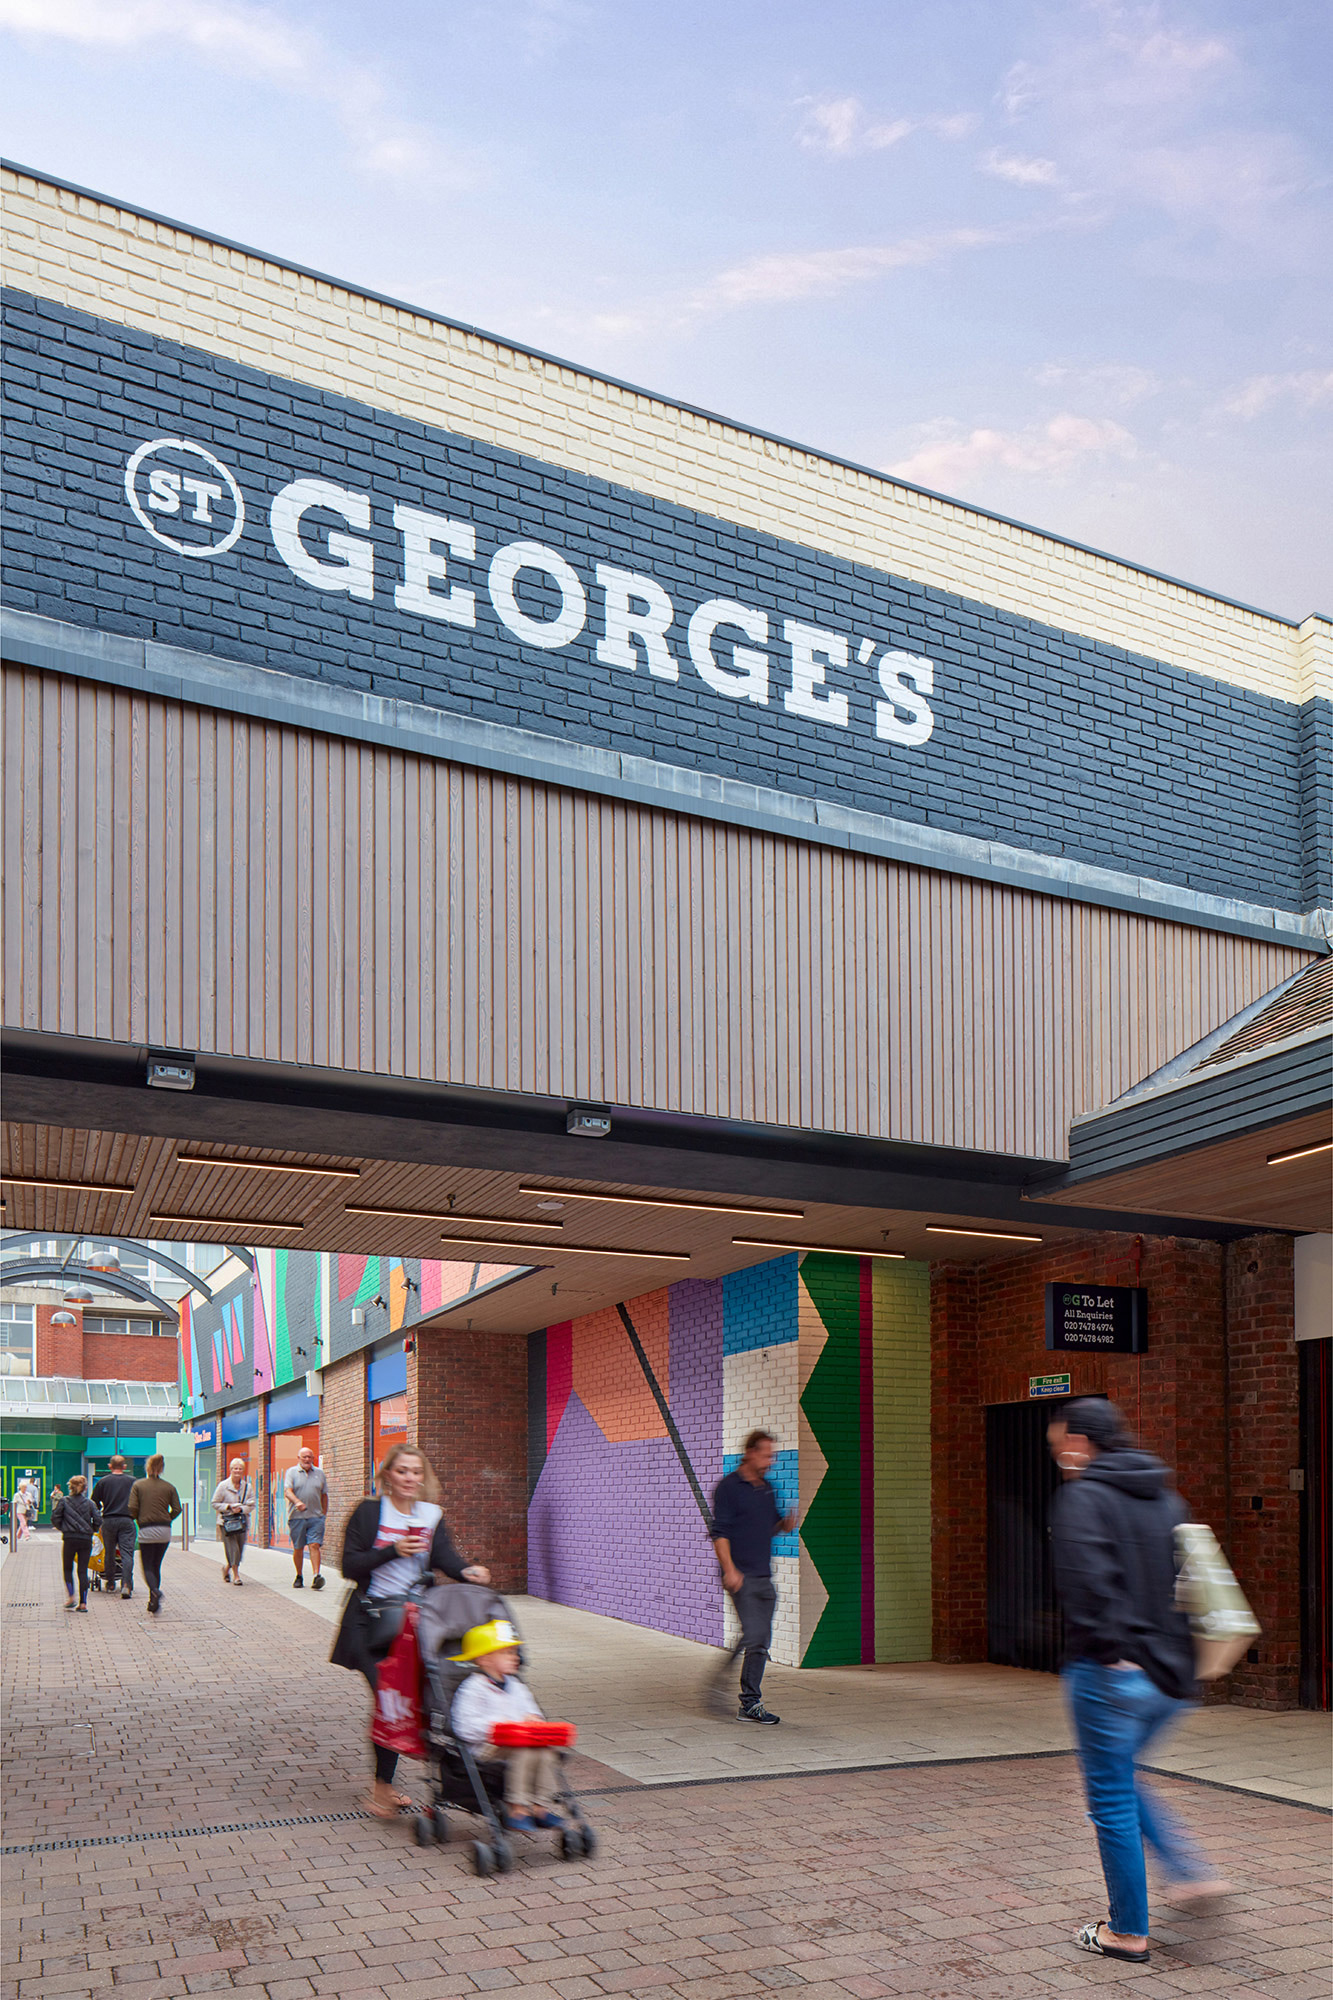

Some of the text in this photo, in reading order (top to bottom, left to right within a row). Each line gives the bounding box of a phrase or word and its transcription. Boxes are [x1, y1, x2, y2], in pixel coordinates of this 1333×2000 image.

[148, 469, 935, 747] ST GEORGE'S
[1072, 1294, 1080, 1306] G
[1081, 1295, 1095, 1307] To
[1097, 1296, 1114, 1308] Let
[1064, 1309, 1113, 1320] All Enquiries
[1064, 1321, 1114, 1332] 020 7478 4974
[1064, 1333, 1114, 1344] 020 7478 4982
